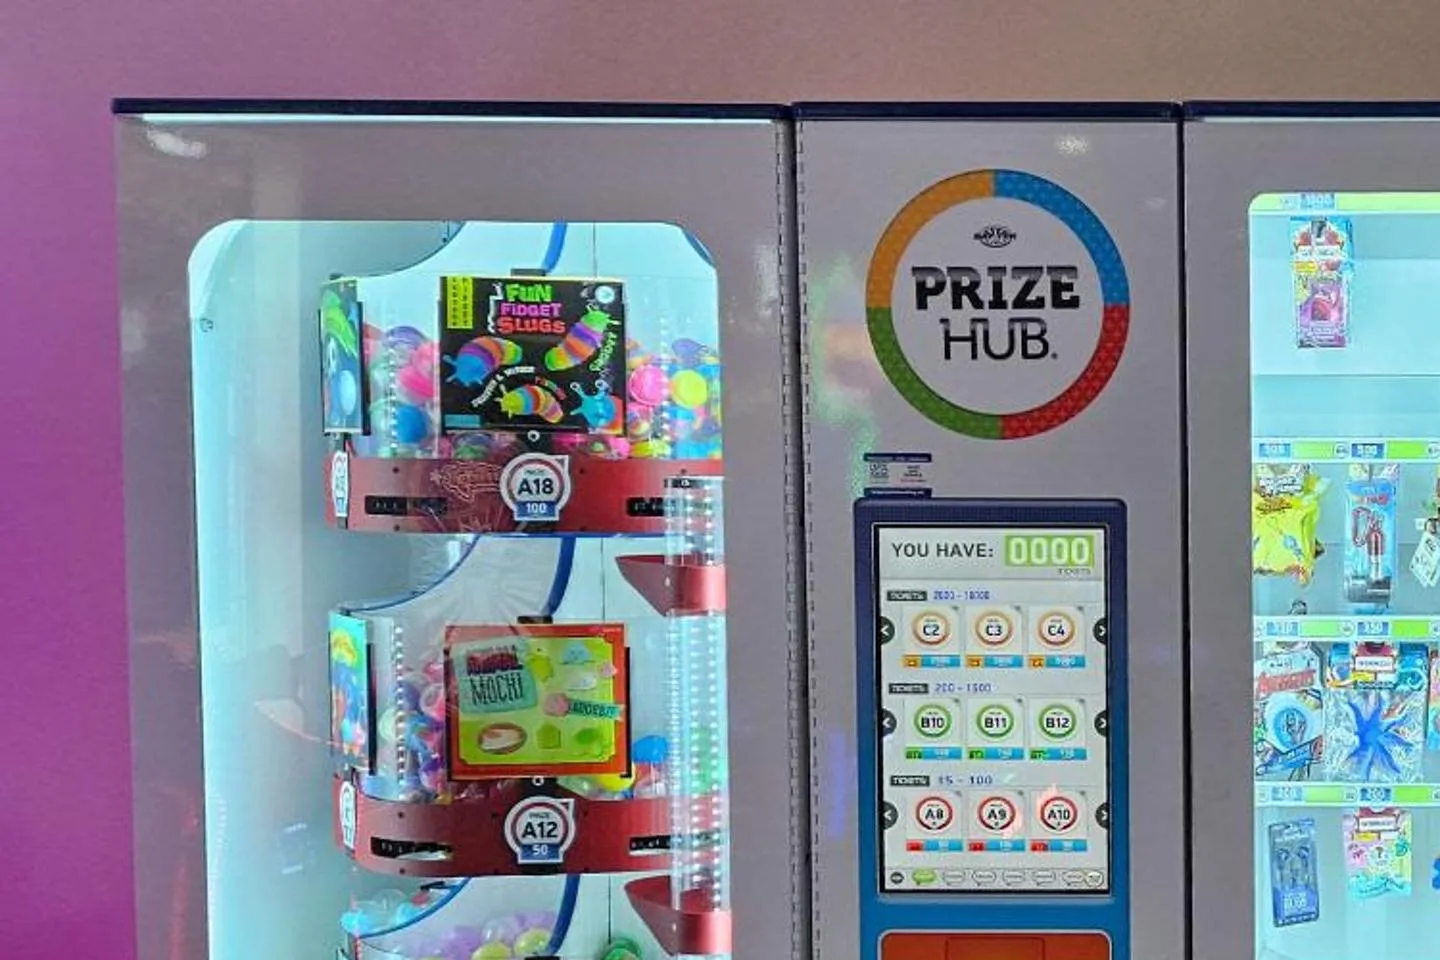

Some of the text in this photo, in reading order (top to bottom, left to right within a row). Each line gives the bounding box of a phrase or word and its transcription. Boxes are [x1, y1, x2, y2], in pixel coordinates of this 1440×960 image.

[506, 284, 552, 302] FUN
[911, 265, 1080, 311] PRIZE
[501, 303, 562, 317] FIDGET
[497, 317, 567, 334] SLUGS
[518, 477, 554, 495] A18
[526, 502, 548, 513] 100
[891, 543, 994, 558] YOU HAVE:
[1008, 536, 1091, 565] 0000
[922, 625, 940, 636] C2
[985, 625, 1004, 636] C3
[1047, 625, 1065, 636] C4
[471, 672, 525, 706] MOCHI
[921, 717, 945, 729] B10
[984, 717, 1008, 729] B11
[1046, 717, 1070, 729] B12
[925, 809, 943, 820] A8
[987, 809, 1007, 820] A9
[1048, 809, 1070, 820] A10
[522, 821, 558, 838] A12
[532, 844, 549, 856] 50
